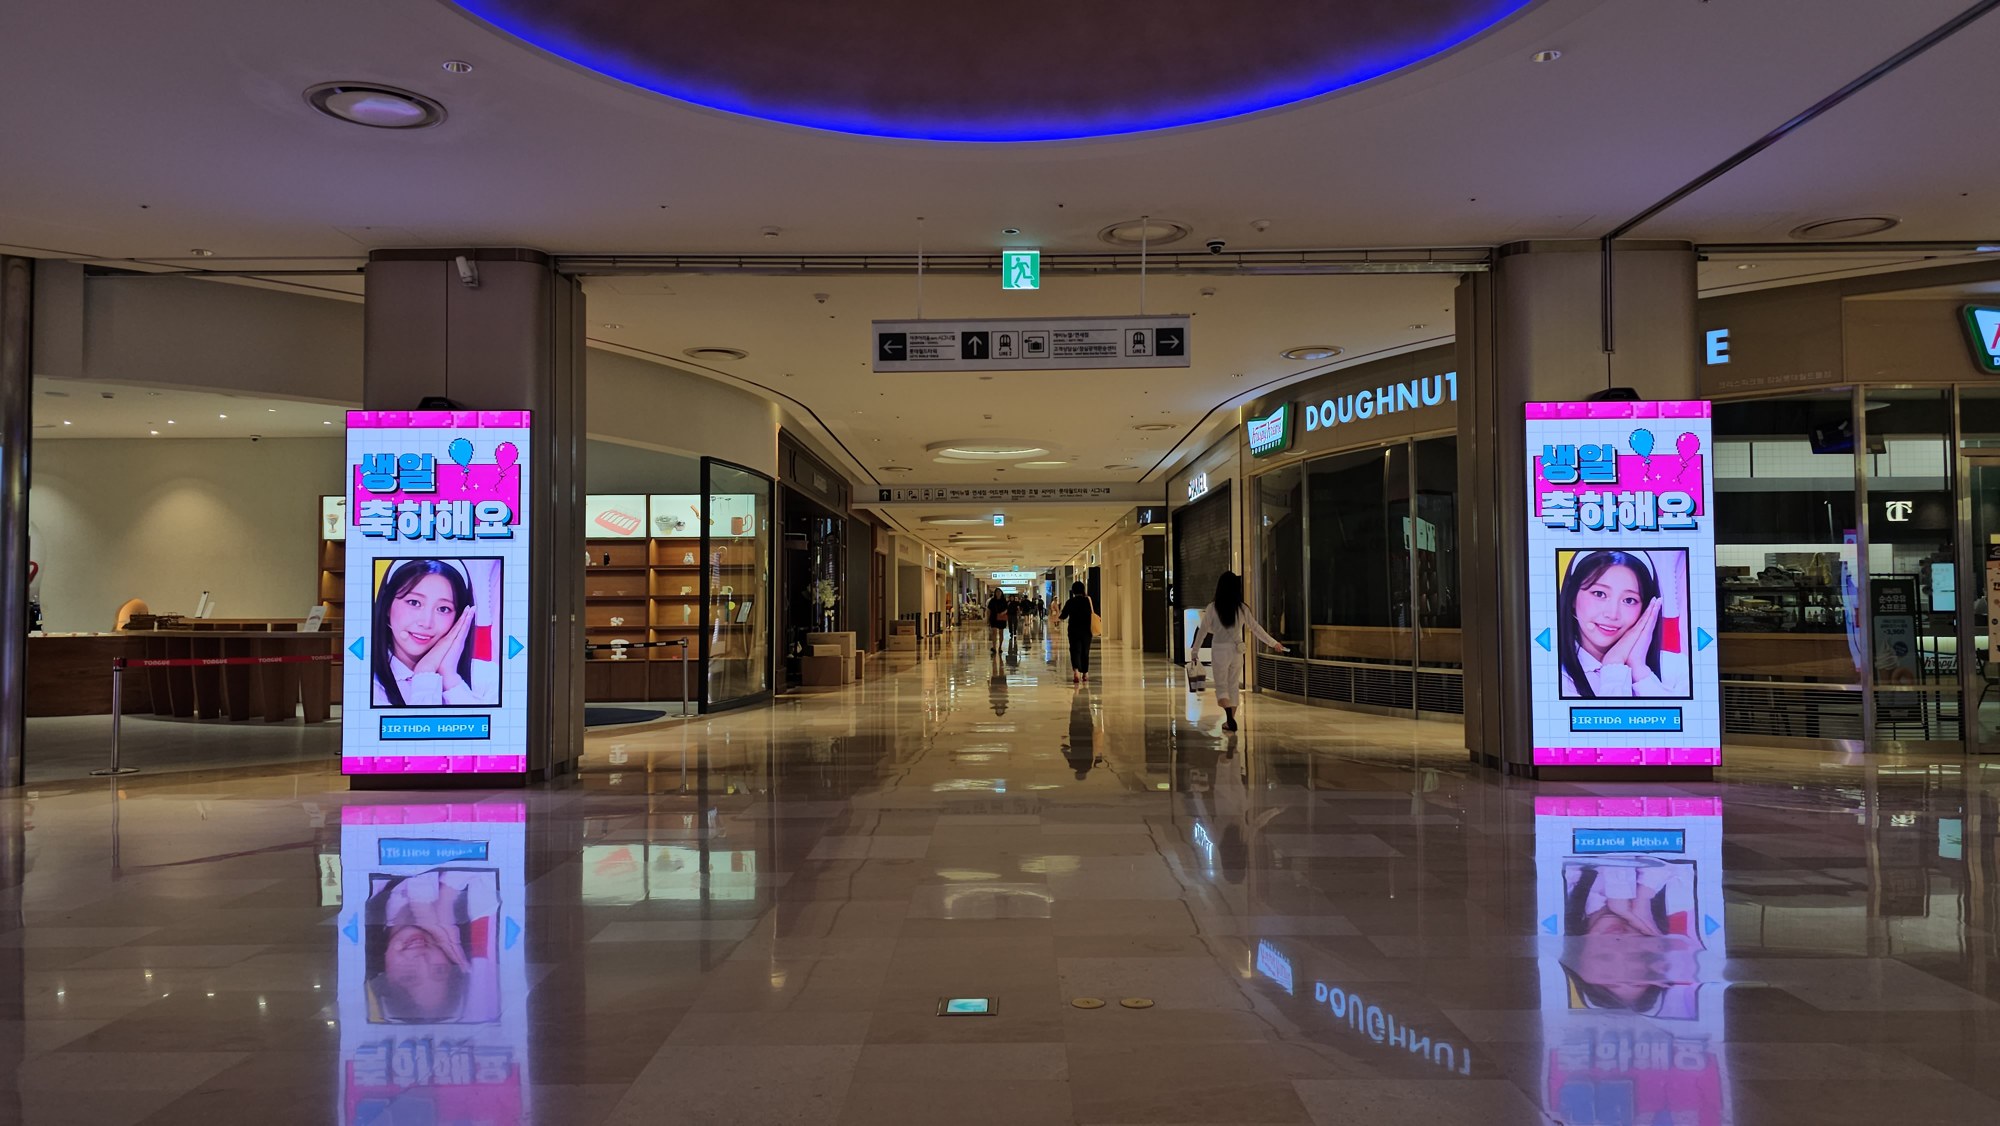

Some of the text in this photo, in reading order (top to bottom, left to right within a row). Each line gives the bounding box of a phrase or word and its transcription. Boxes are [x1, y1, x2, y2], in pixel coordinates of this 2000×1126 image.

[360, 453, 436, 493] 생일
[1540, 444, 1616, 483] 생일
[359, 499, 513, 541] 축하해요
[1540, 490, 1698, 532] 축하해요
[438, 724, 475, 732] HAPPY
[1628, 716, 1667, 724] HAPPY
